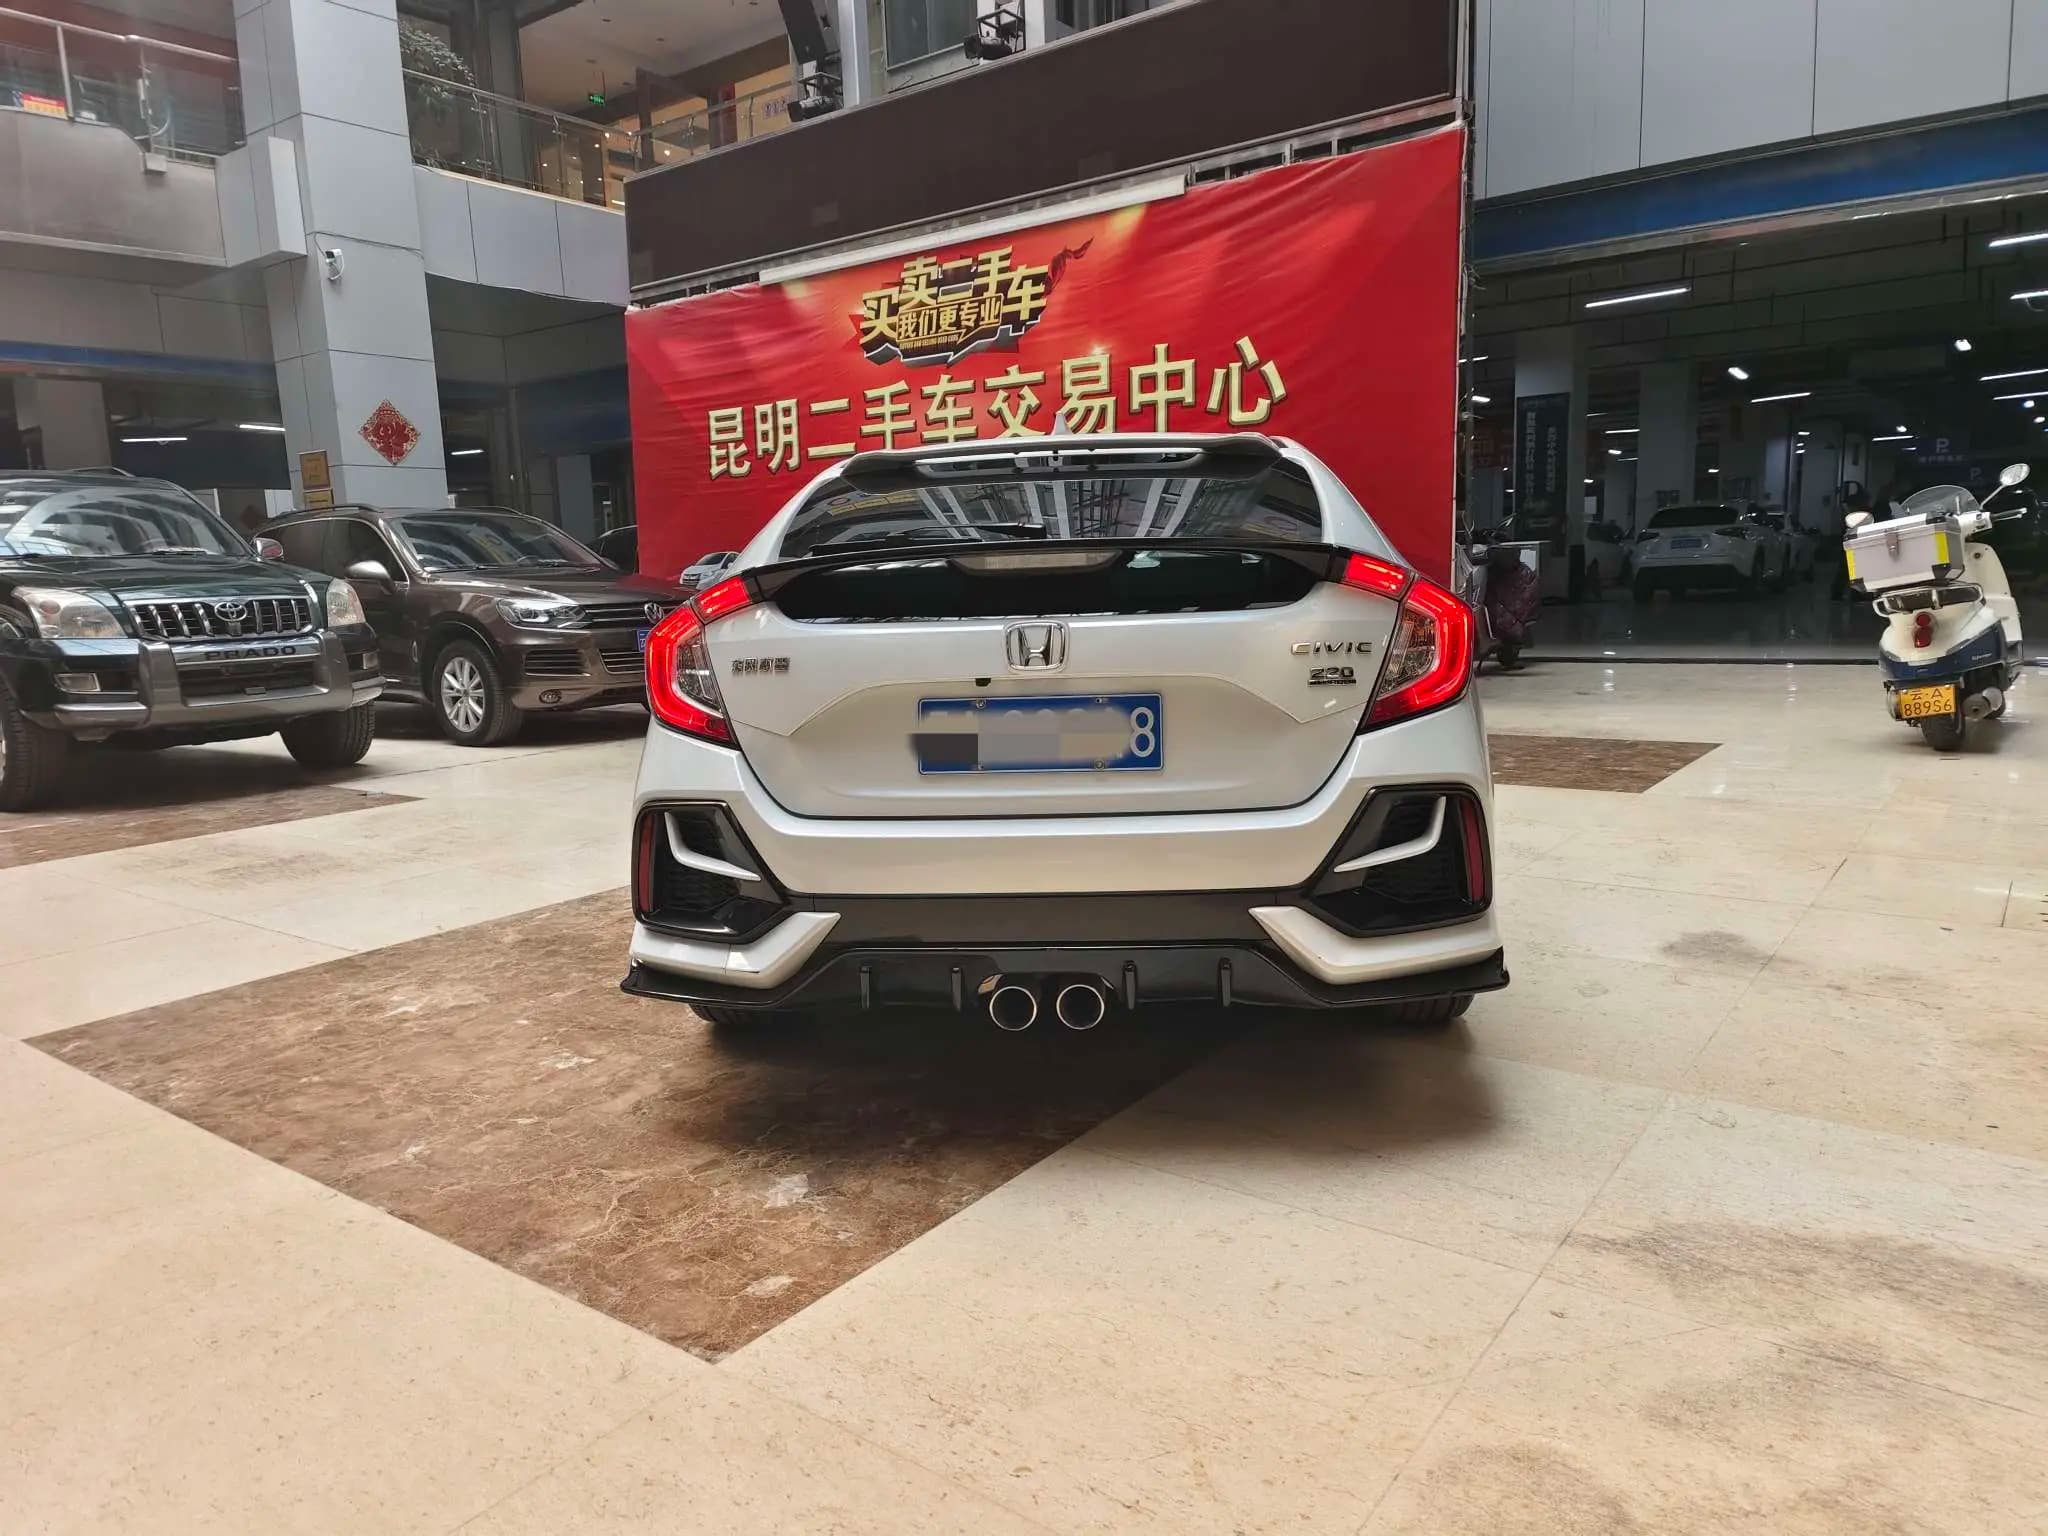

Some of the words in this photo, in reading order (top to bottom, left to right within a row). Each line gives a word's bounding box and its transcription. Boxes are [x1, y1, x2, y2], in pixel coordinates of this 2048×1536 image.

[860, 245, 1049, 344] 买卖二手车
[899, 297, 1000, 340] 我们更专业
[707, 336, 1286, 480] 昆明二手车交易中心
[205, 645, 297, 660] PRADO
[1291, 641, 1373, 655] CIVIC
[1310, 667, 1354, 679] 220
